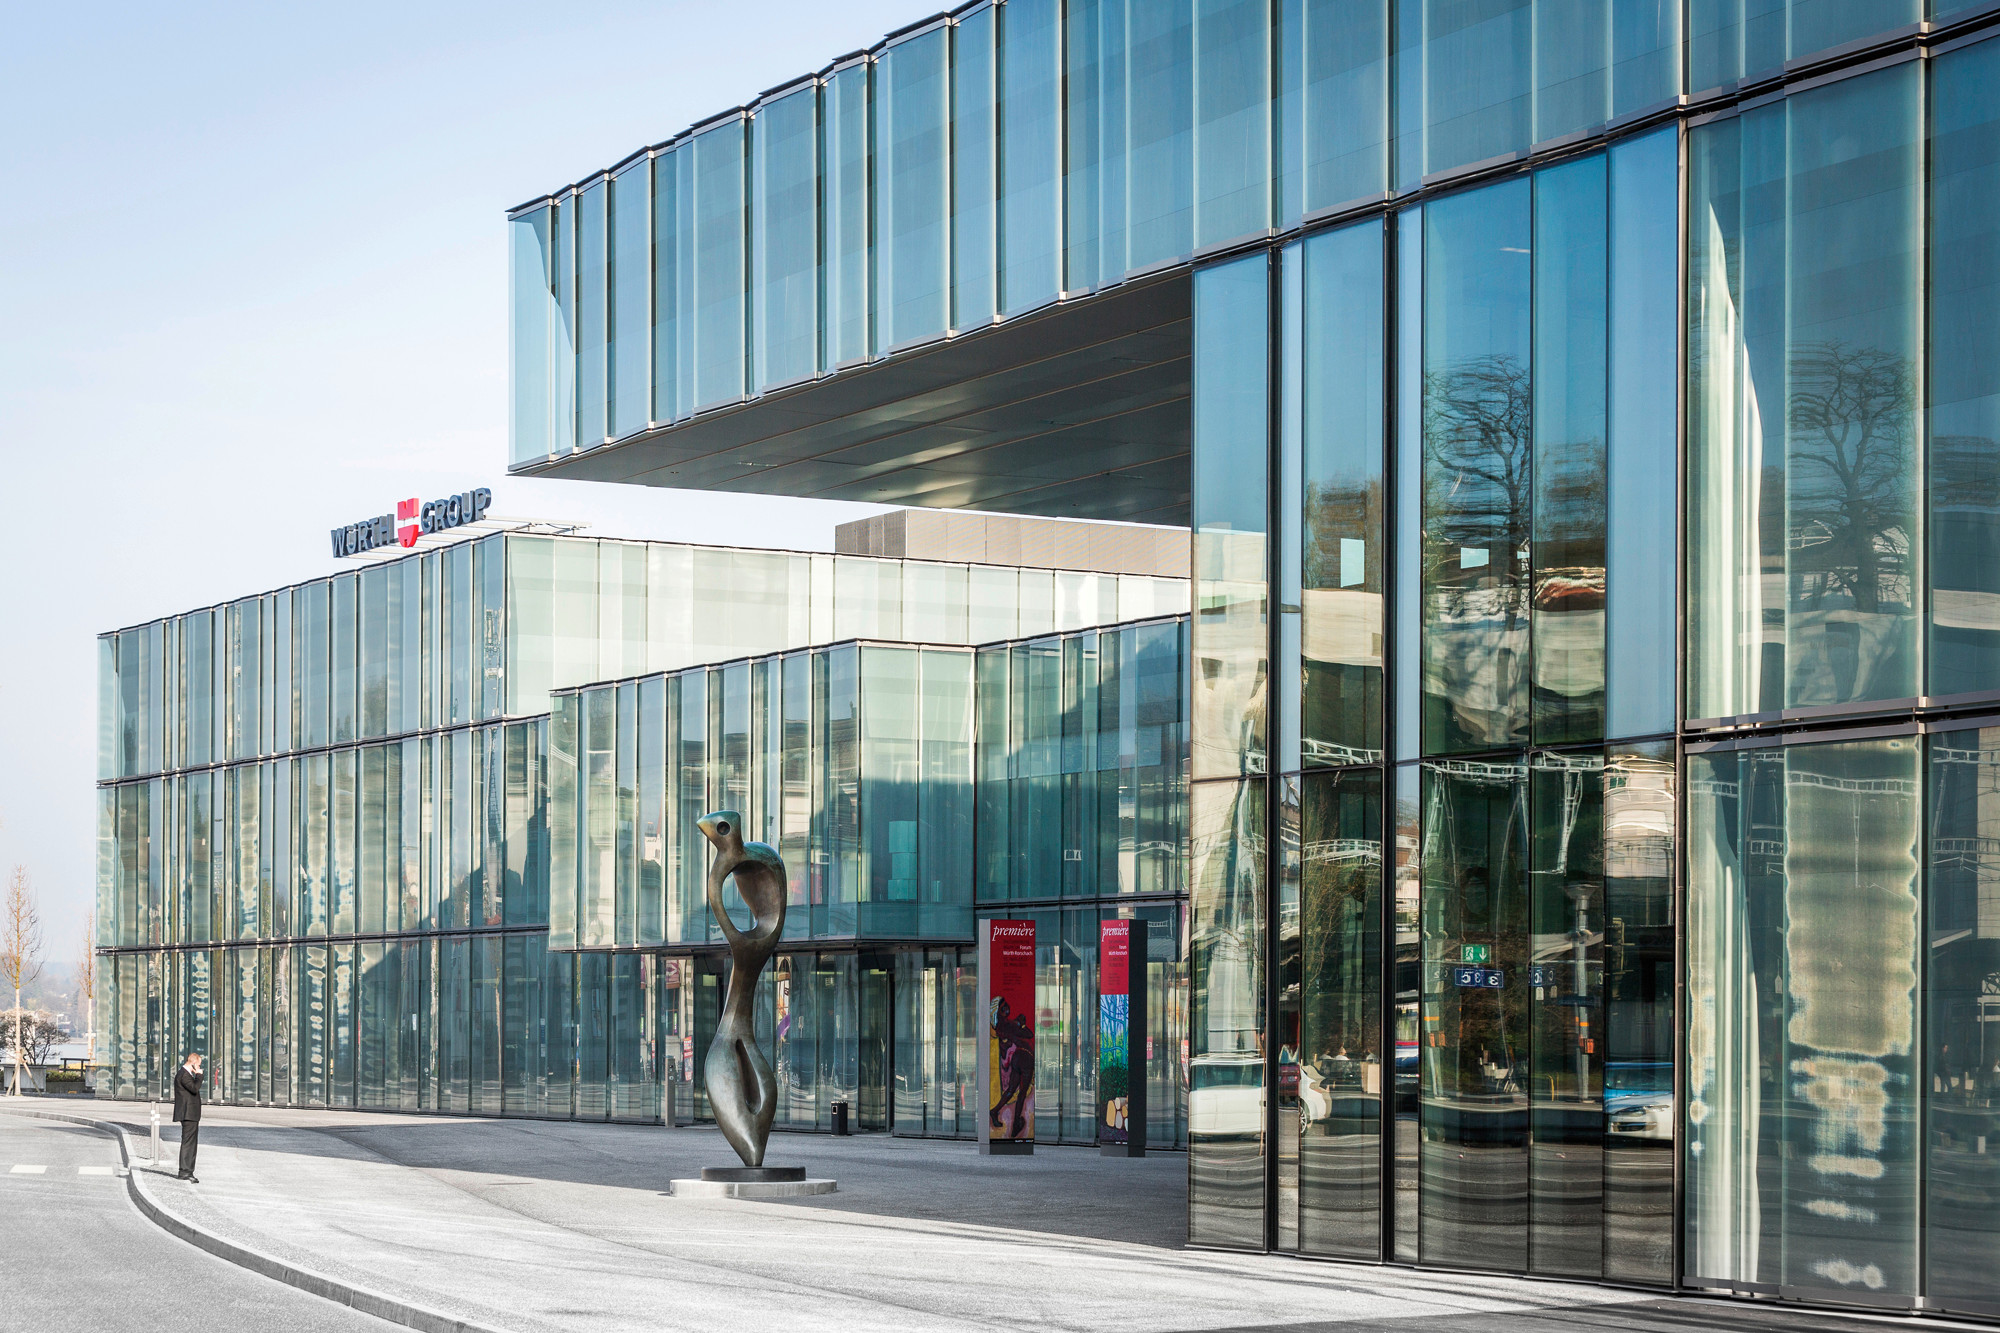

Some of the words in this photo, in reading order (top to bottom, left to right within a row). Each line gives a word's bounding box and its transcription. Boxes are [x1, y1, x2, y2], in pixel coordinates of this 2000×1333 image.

[421, 488, 491, 534] GROUP
[992, 922, 1035, 942] première
[1102, 922, 1129, 943] première
